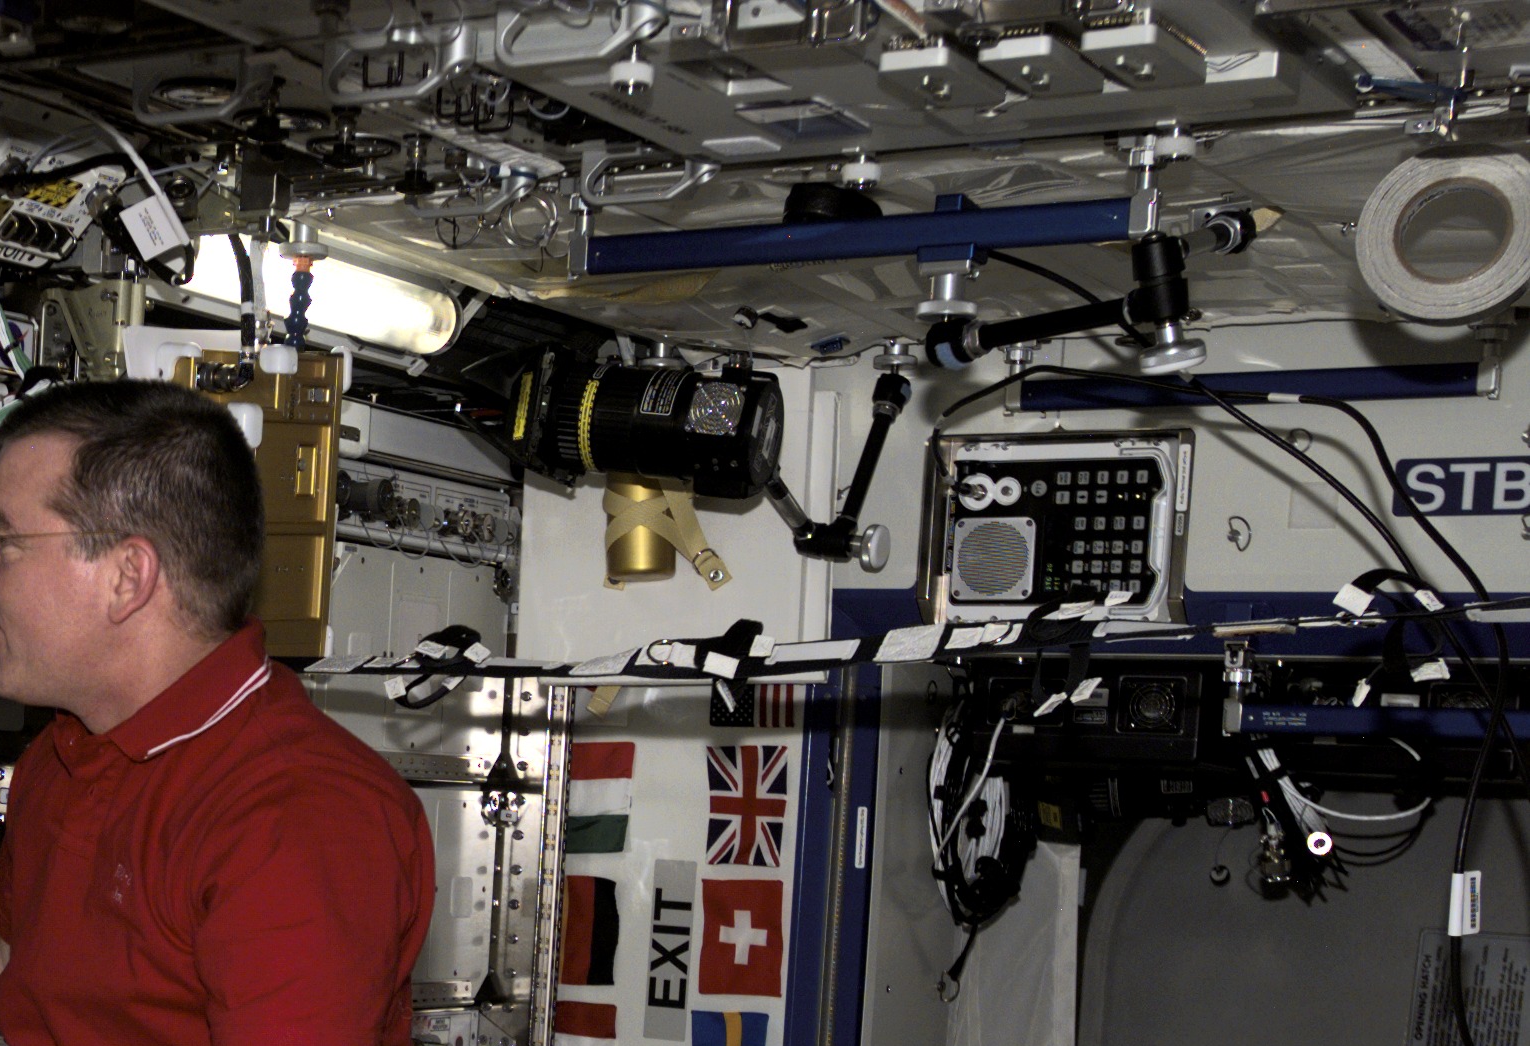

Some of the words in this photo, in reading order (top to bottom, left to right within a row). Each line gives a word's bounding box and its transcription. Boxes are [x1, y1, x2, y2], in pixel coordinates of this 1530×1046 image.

[1406, 462, 1530, 513] STB
[648, 888, 692, 1009] EXIT
[1420, 954, 1432, 989] HATCH
[1414, 991, 1428, 1041] OPENING
